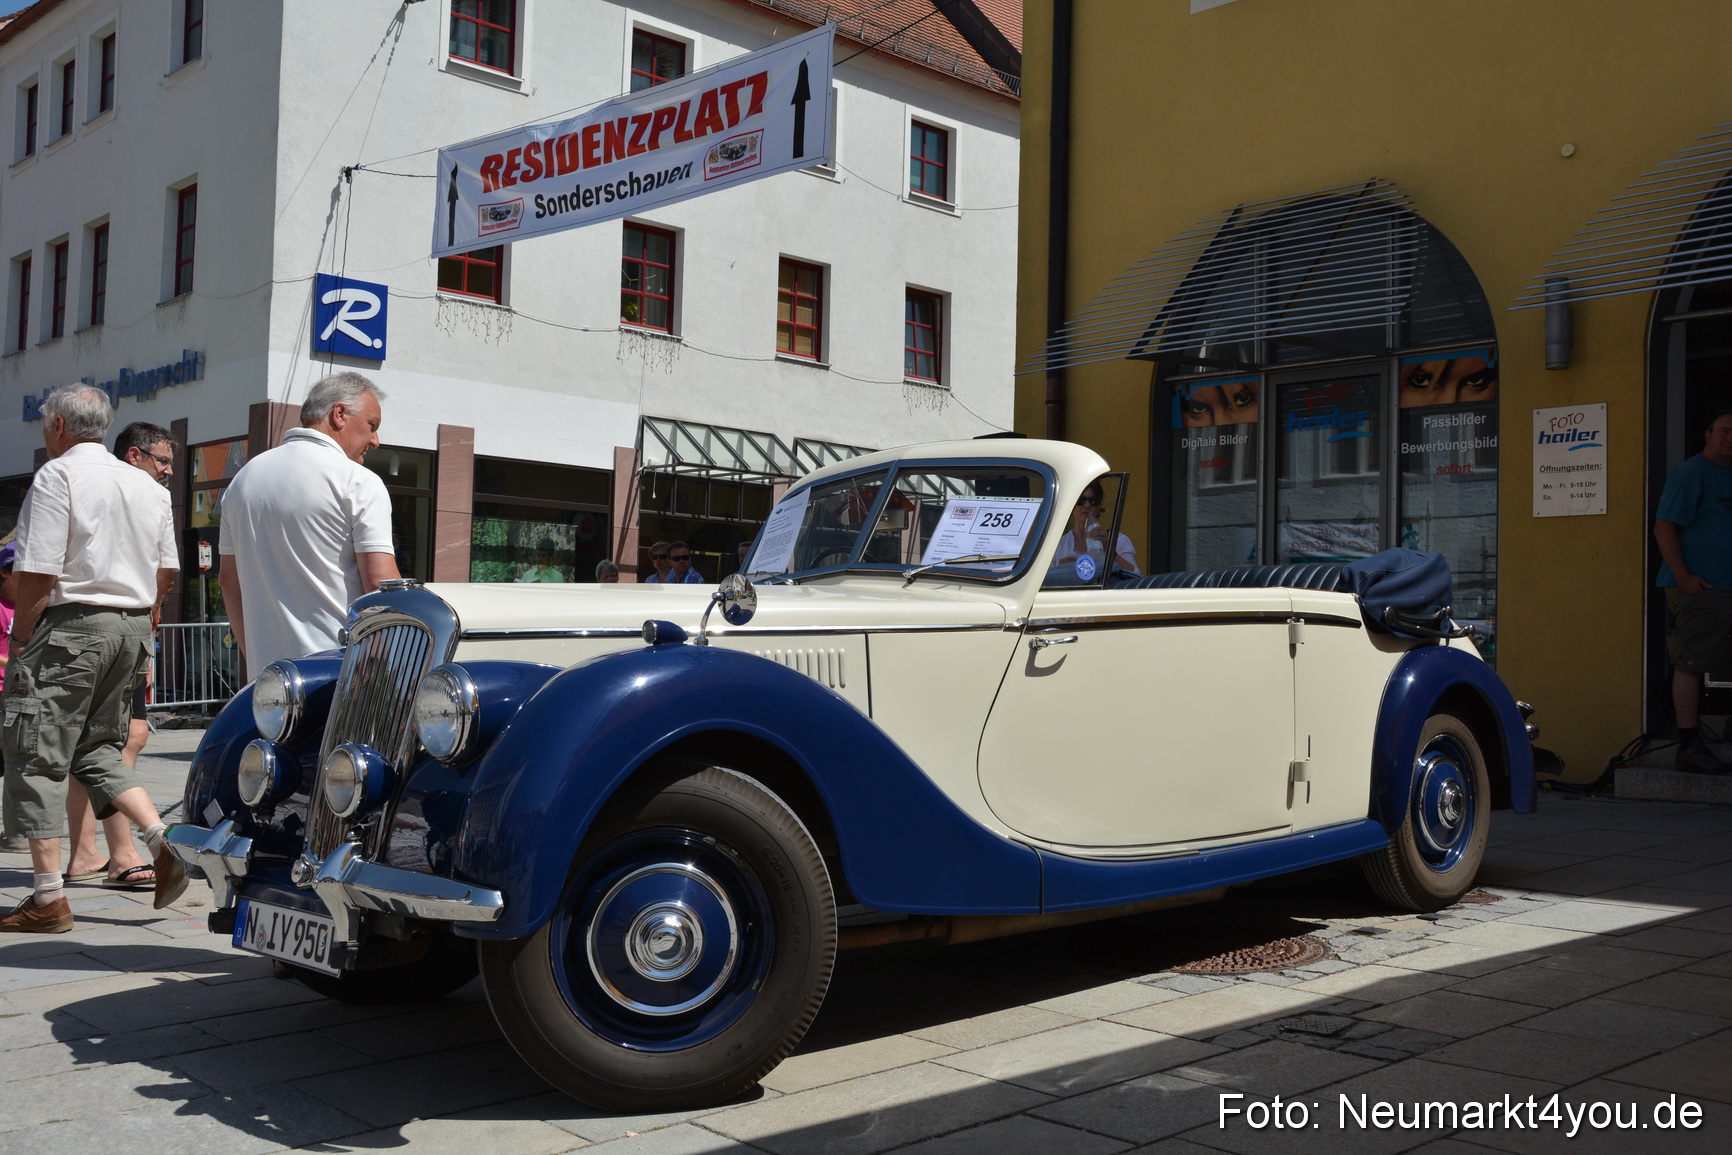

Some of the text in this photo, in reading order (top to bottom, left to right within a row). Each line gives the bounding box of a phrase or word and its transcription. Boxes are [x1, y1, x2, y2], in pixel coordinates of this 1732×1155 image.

[478, 70, 768, 194] RESIDENZPLATZ
[534, 159, 694, 219] Sonderschauen
[119, 348, 205, 404] Rupprecht
[1304, 381, 1353, 413] FOTO
[1422, 413, 1488, 429] Passbilder
[1548, 412, 1585, 432] FOTO
[1181, 434, 1249, 450] Digitale Bilder
[1401, 436, 1498, 455] Bewerbungsbild
[1538, 428, 1600, 445] hailer
[1436, 462, 1473, 476] sofort
[1539, 463, 1603, 473] Öffnungszeiten:
[980, 512, 1014, 529] 258
[243, 905, 259, 944] N
